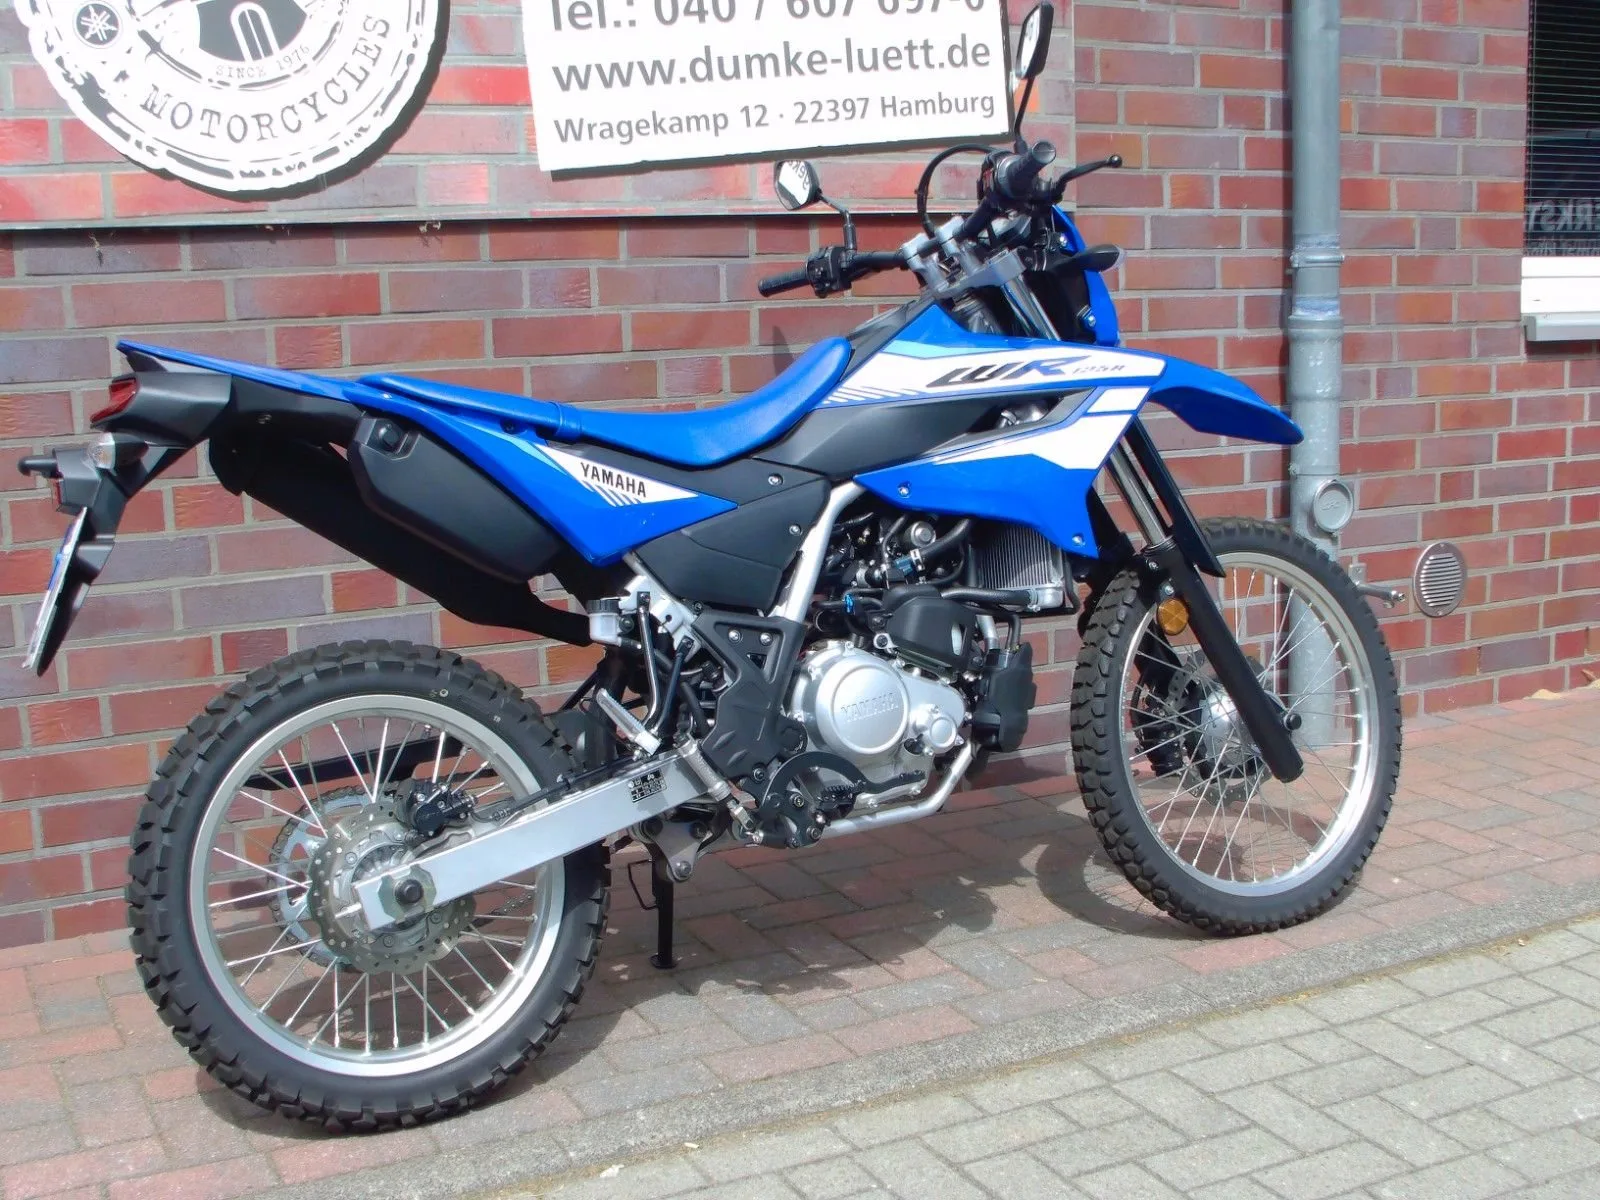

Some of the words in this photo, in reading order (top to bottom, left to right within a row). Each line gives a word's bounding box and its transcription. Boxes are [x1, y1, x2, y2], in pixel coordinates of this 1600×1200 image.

[655, 0, 736, 26] 040
[139, 14, 391, 144] MOTORCYCLES
[215, 64, 268, 80] SINCE
[275, 45, 311, 72] 1976
[552, 33, 990, 91] www.dumke-luett.de
[554, 110, 729, 145] Wragekamp
[740, 104, 769, 128] 12
[793, 97, 870, 124] 22397
[880, 91, 995, 119] Hamburg
[925, 354, 1092, 388] WR
[579, 461, 647, 498] YAMAHA
[841, 691, 900, 724] YAMAHA
